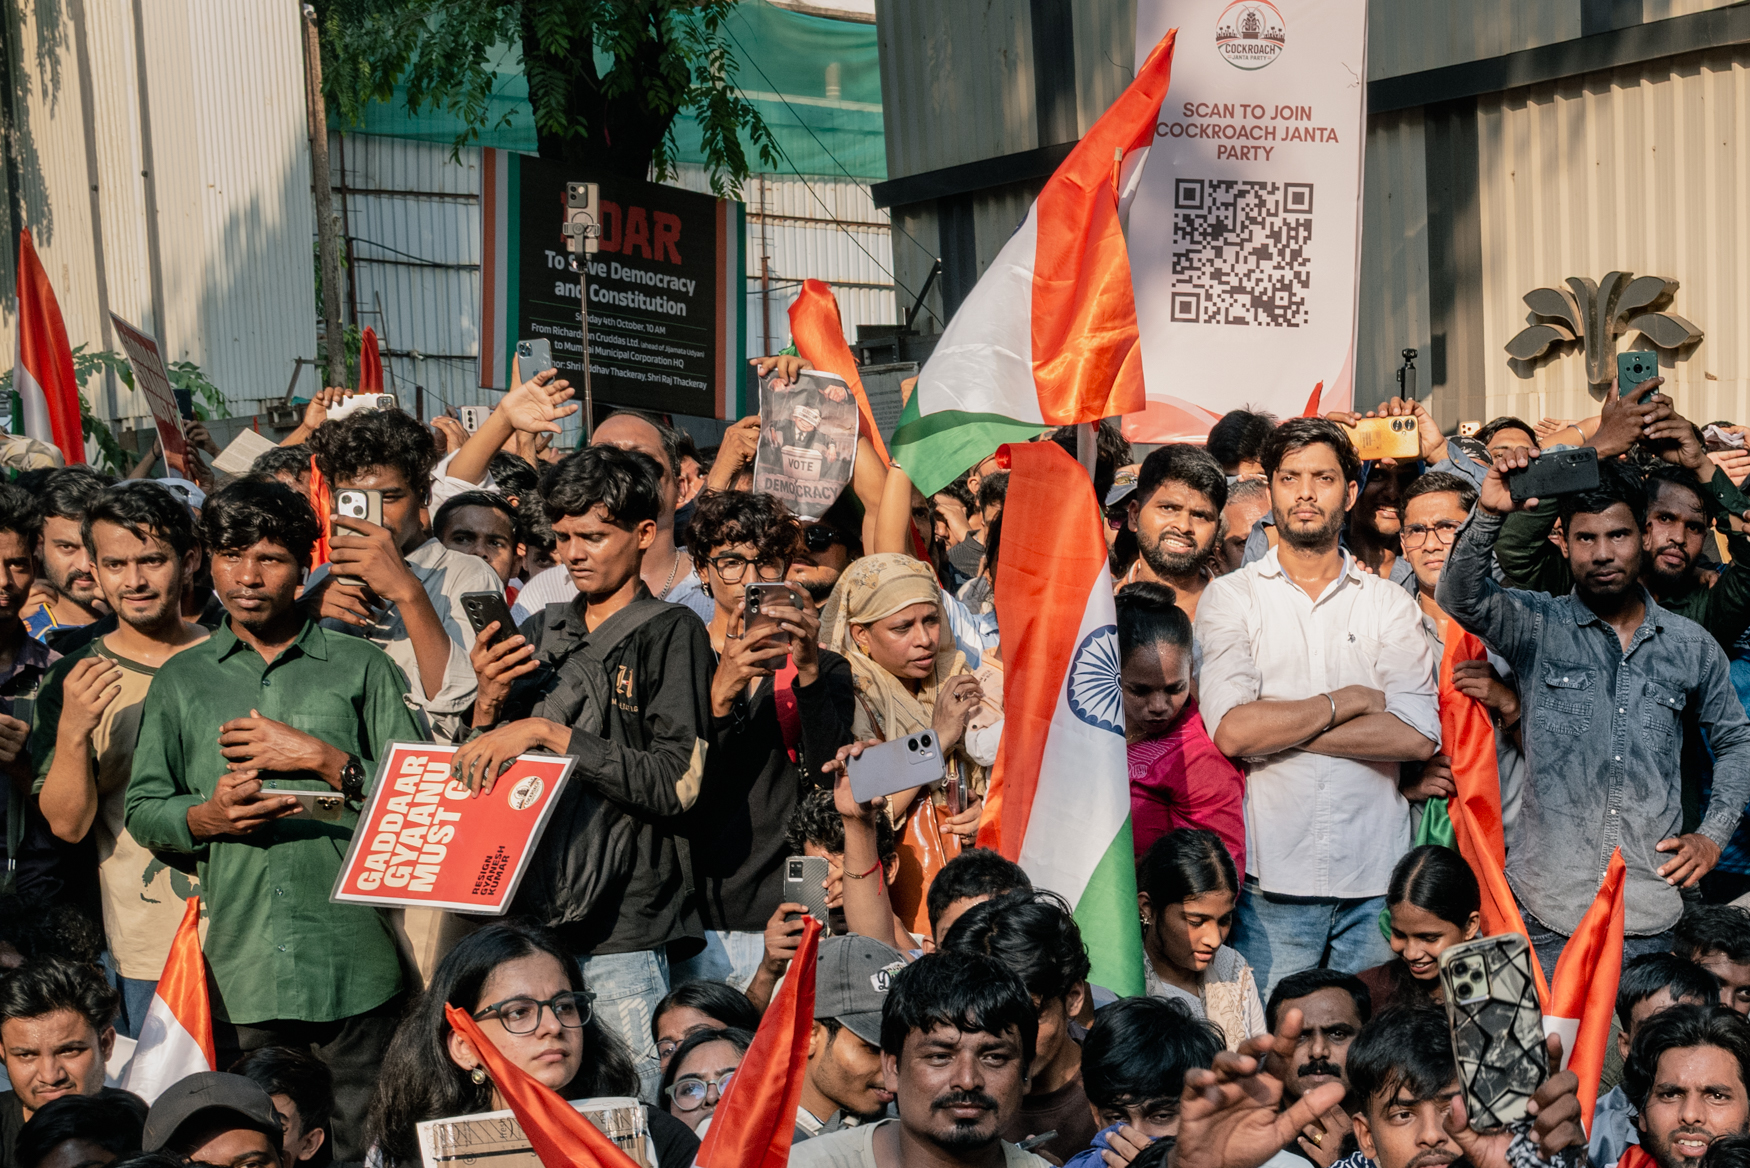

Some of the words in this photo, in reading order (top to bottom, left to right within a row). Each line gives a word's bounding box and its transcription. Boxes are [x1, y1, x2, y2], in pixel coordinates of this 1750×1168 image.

[1225, 43, 1276, 55] COCKROACH
[1182, 102, 1235, 119] SCAN
[1240, 104, 1266, 120] TO
[1270, 105, 1312, 121] JOIN
[1155, 122, 1277, 141] COCKROACH
[1281, 126, 1339, 143] JANTA
[1217, 144, 1275, 161] PARTY
[545, 250, 565, 270] To
[610, 262, 696, 297] Democracy
[589, 284, 687, 316] Constitution
[531, 323, 552, 334] From
[595, 332, 626, 346] Cruddas
[626, 335, 640, 347] Ltd.
[603, 316, 616, 327] 4th
[646, 323, 654, 333] 10
[654, 324, 666, 335] AM
[554, 341, 564, 350] to
[595, 346, 630, 360] Municipal
[630, 351, 673, 366] Corporation
[673, 358, 685, 369] HQ
[566, 360, 581, 371] Shri
[610, 367, 647, 382] Thackeray,
[647, 372, 661, 382] Shri
[661, 374, 673, 386] Raj
[673, 376, 708, 391] Thackeray
[788, 457, 814, 472] VOTE
[764, 477, 839, 499] DEMOCRACY
[356, 755, 429, 891] GADDAAR
[383, 761, 452, 888] GYAANU
[407, 807, 462, 893] MUST
[471, 855, 493, 895] RESIGN
[480, 845, 506, 896] GYANESH
[487, 855, 510, 896] KUMAR
